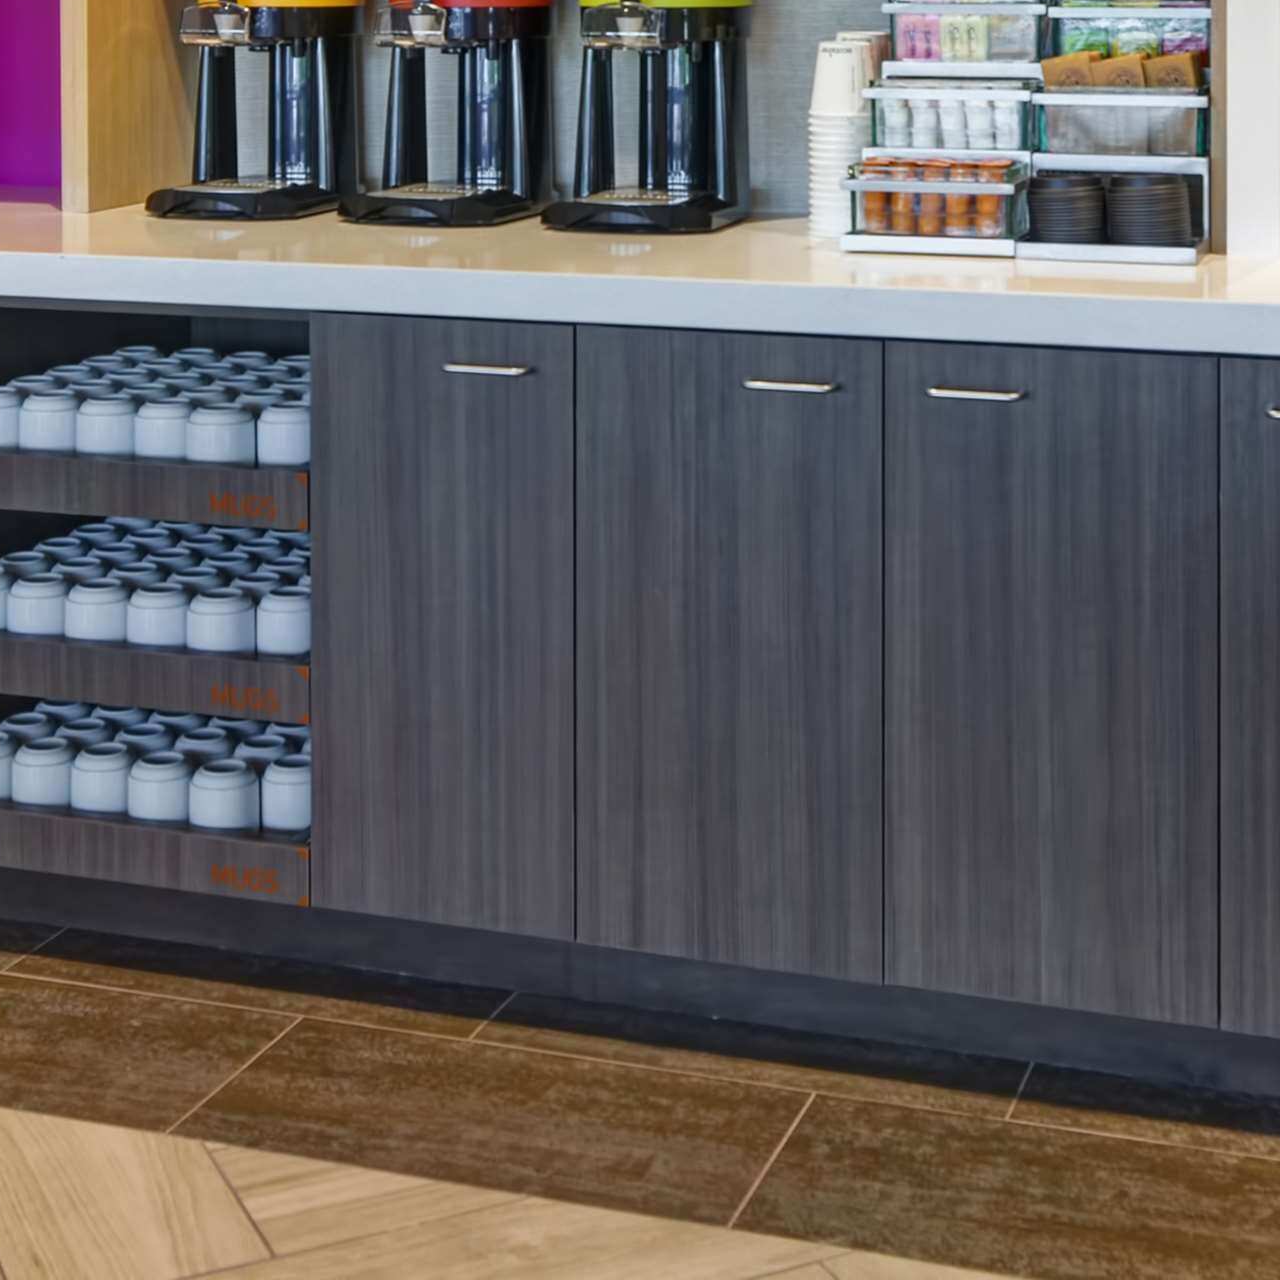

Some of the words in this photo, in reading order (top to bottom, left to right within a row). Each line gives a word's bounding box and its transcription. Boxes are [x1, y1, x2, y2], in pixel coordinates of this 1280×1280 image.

[209, 492, 277, 520] MUGS
[211, 682, 280, 713] MUGS
[211, 863, 280, 894] MUGS
